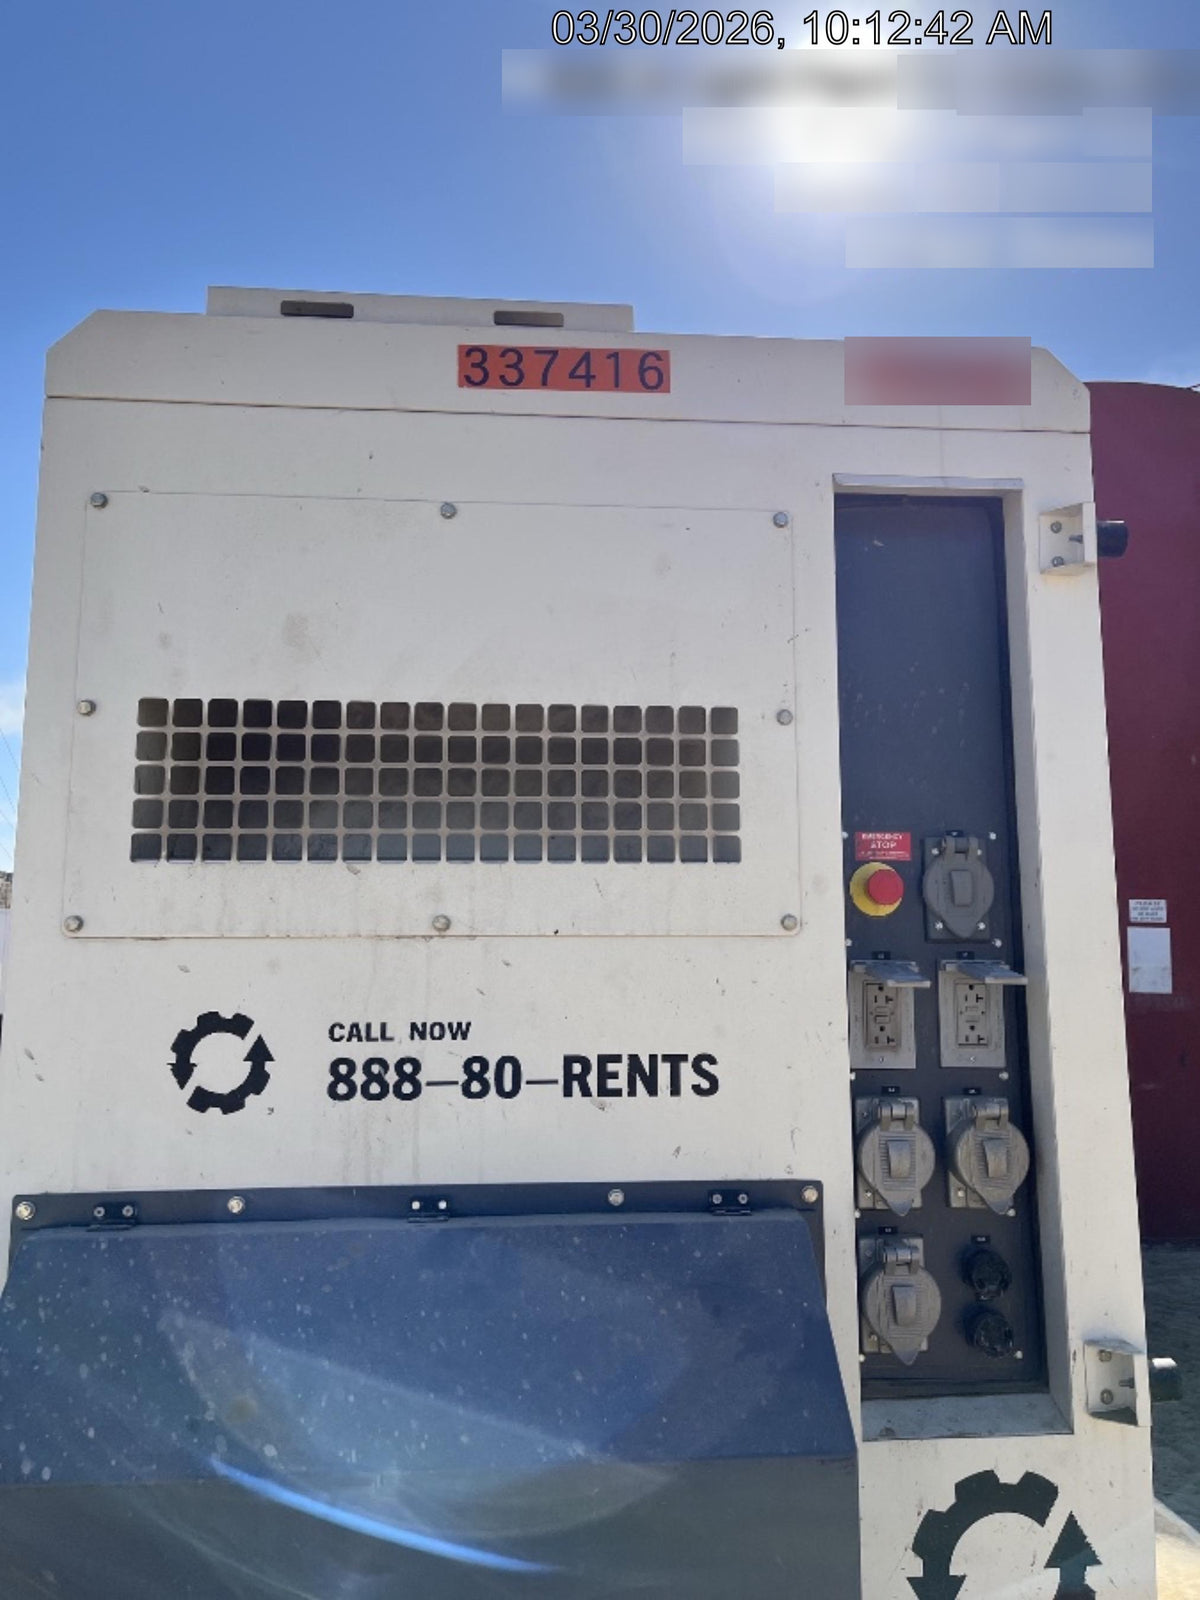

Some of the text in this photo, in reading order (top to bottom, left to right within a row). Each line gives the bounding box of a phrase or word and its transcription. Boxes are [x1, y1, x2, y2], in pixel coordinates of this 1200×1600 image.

[464, 347, 664, 391] 337416
[328, 1021, 472, 1042] CALL NOW
